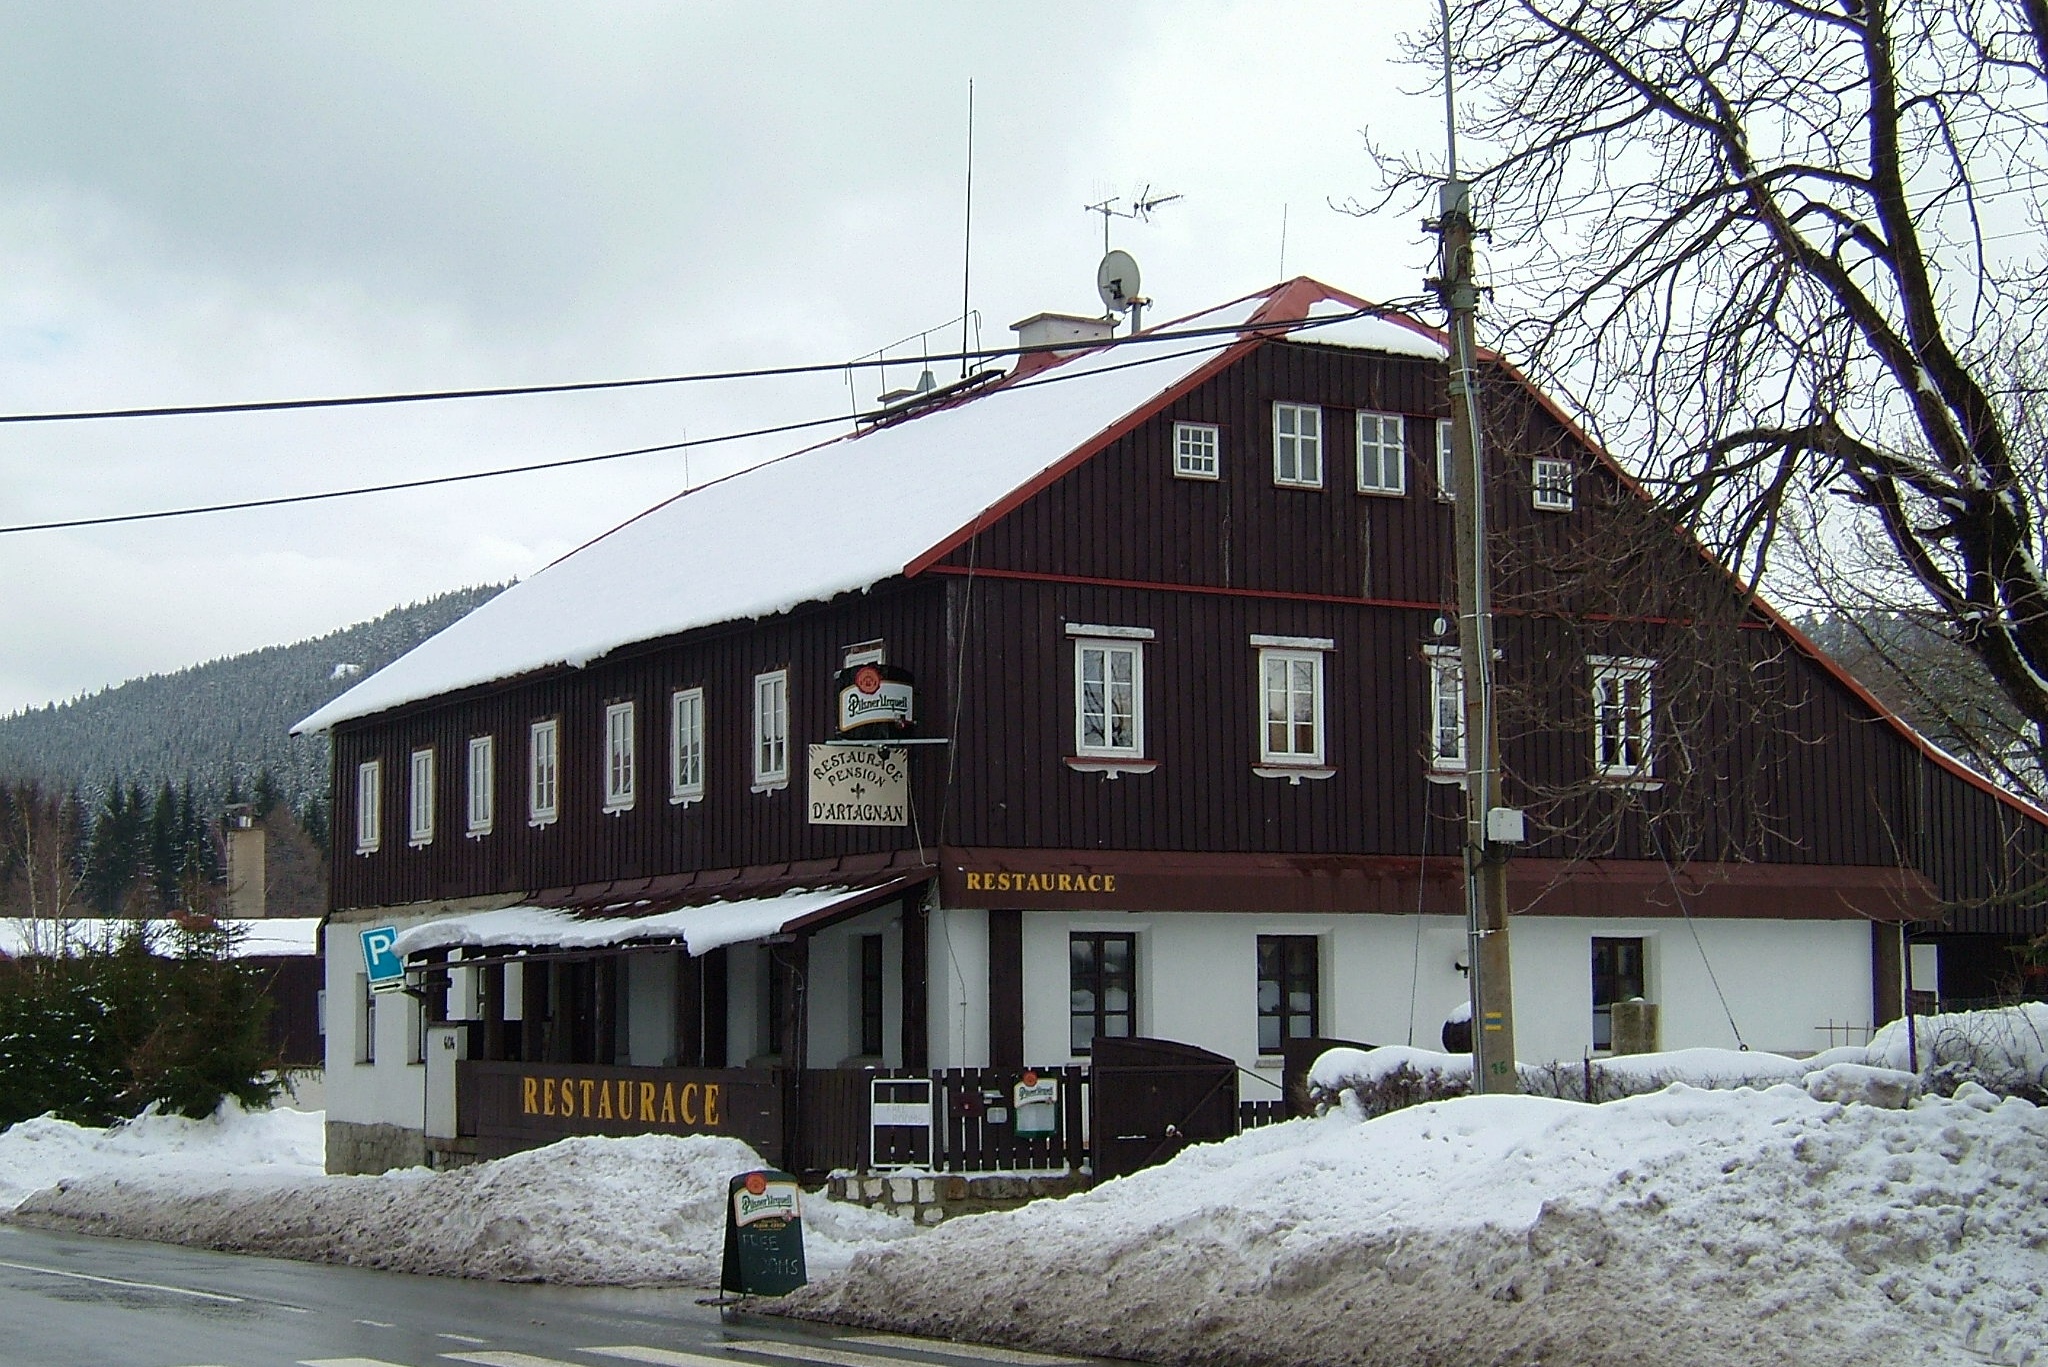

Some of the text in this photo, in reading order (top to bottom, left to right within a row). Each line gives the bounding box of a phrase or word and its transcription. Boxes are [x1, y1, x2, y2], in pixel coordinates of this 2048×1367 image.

[848, 693, 908, 718] Pilsner Urquell
[828, 766, 886, 788] PENSION
[813, 802, 903, 821] D'ARTAGNAN
[967, 872, 1116, 892] RESTAURACE
[369, 934, 390, 966] P
[523, 1076, 720, 1126] RESTAURACE
